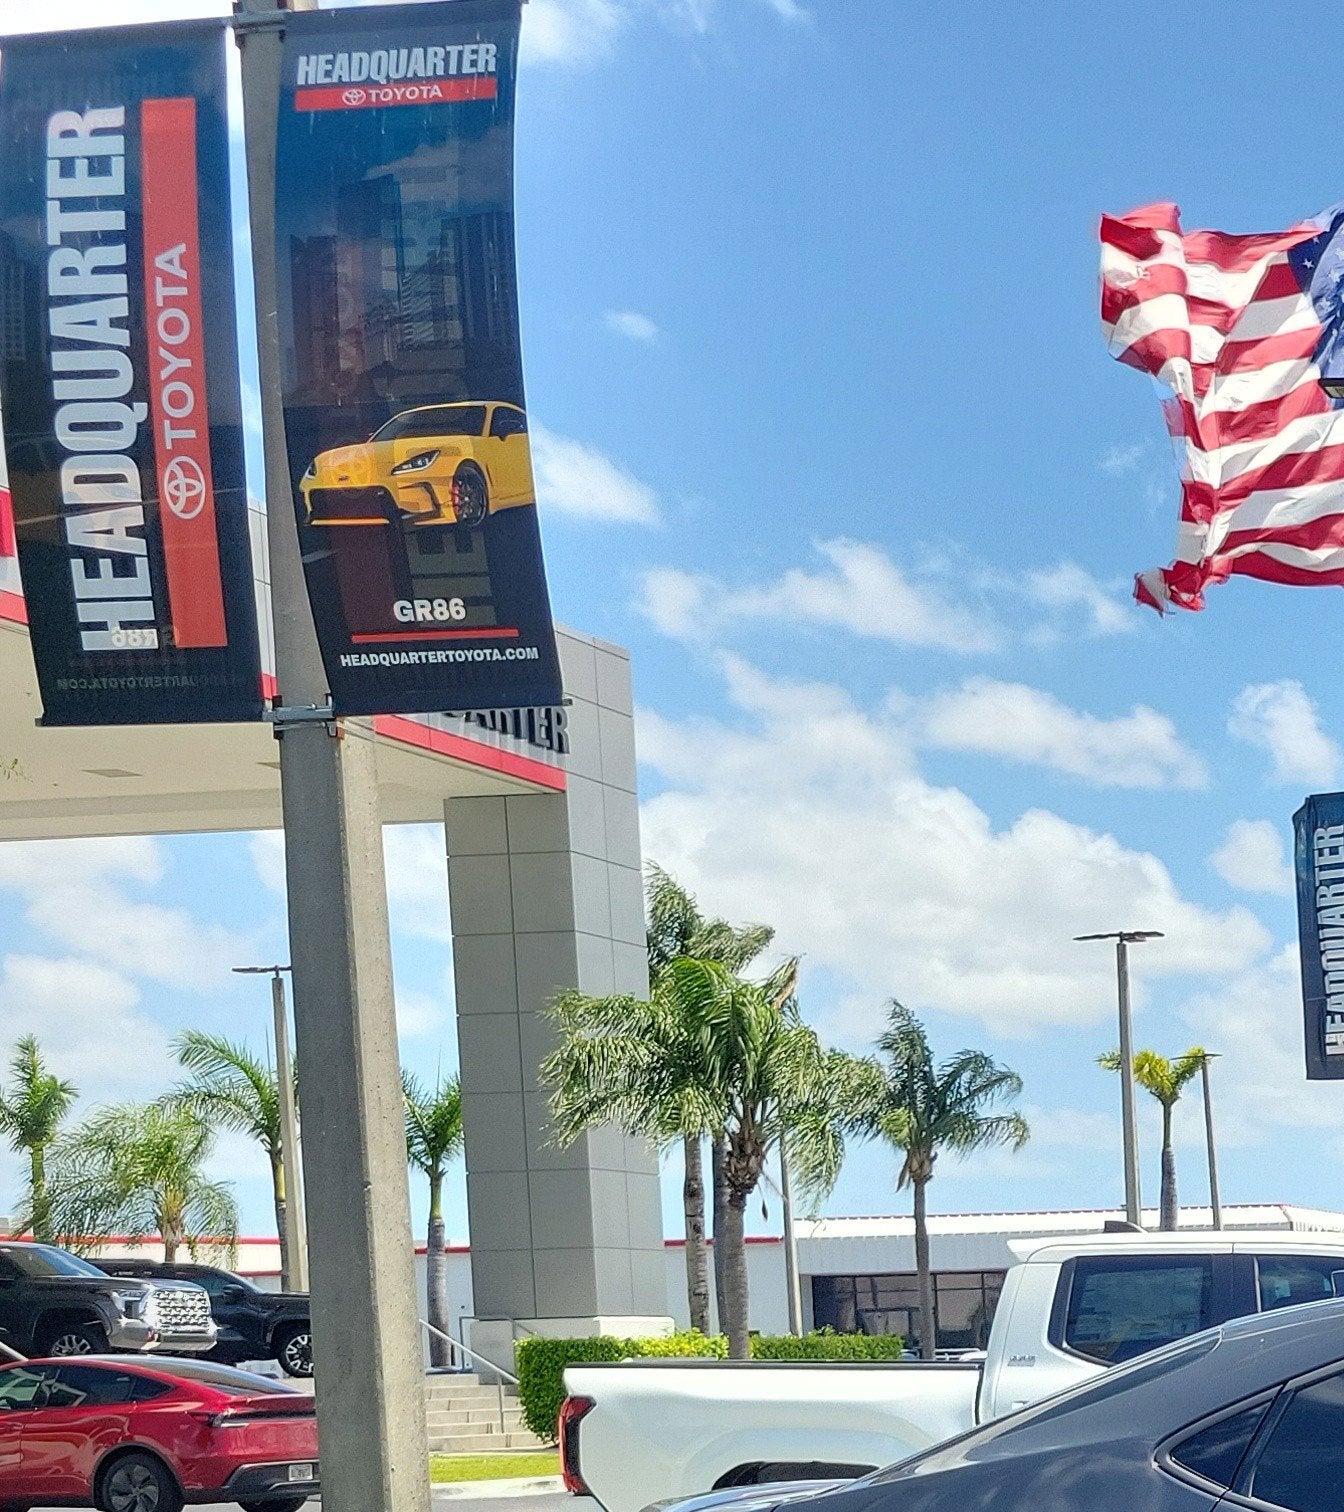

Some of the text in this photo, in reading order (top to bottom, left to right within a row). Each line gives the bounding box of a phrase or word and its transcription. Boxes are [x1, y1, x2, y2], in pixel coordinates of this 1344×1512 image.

[297, 43, 497, 85] HEADQUARTER
[368, 84, 442, 104] TOYOTA
[151, 243, 196, 449] TOYOTA
[47, 105, 159, 650] HEADQUARTER
[393, 597, 466, 623] GR86
[340, 646, 540, 667] HEADQUARTERTOYOTA.COM
